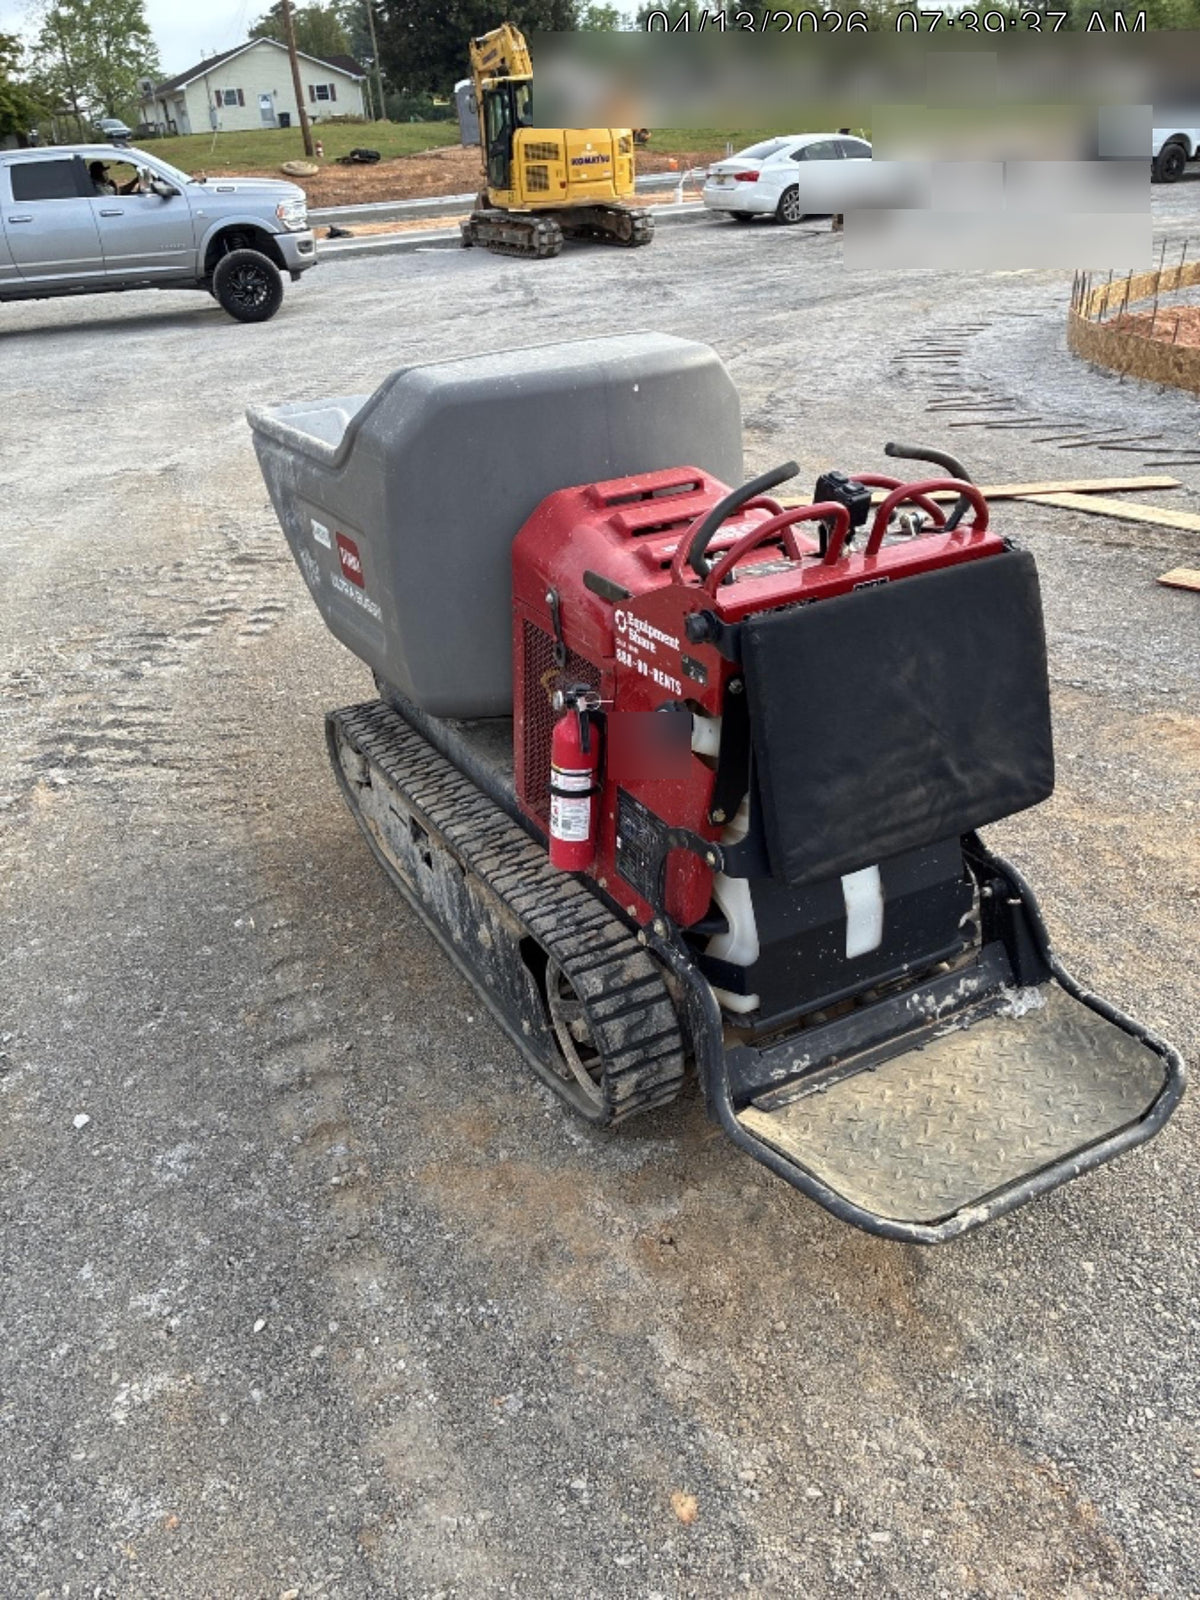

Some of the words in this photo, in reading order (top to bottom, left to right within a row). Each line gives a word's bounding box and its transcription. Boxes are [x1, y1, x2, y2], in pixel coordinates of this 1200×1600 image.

[571, 155, 610, 166] KOMATSU
[627, 611, 680, 652] Equipment
[629, 627, 657, 654] Share
